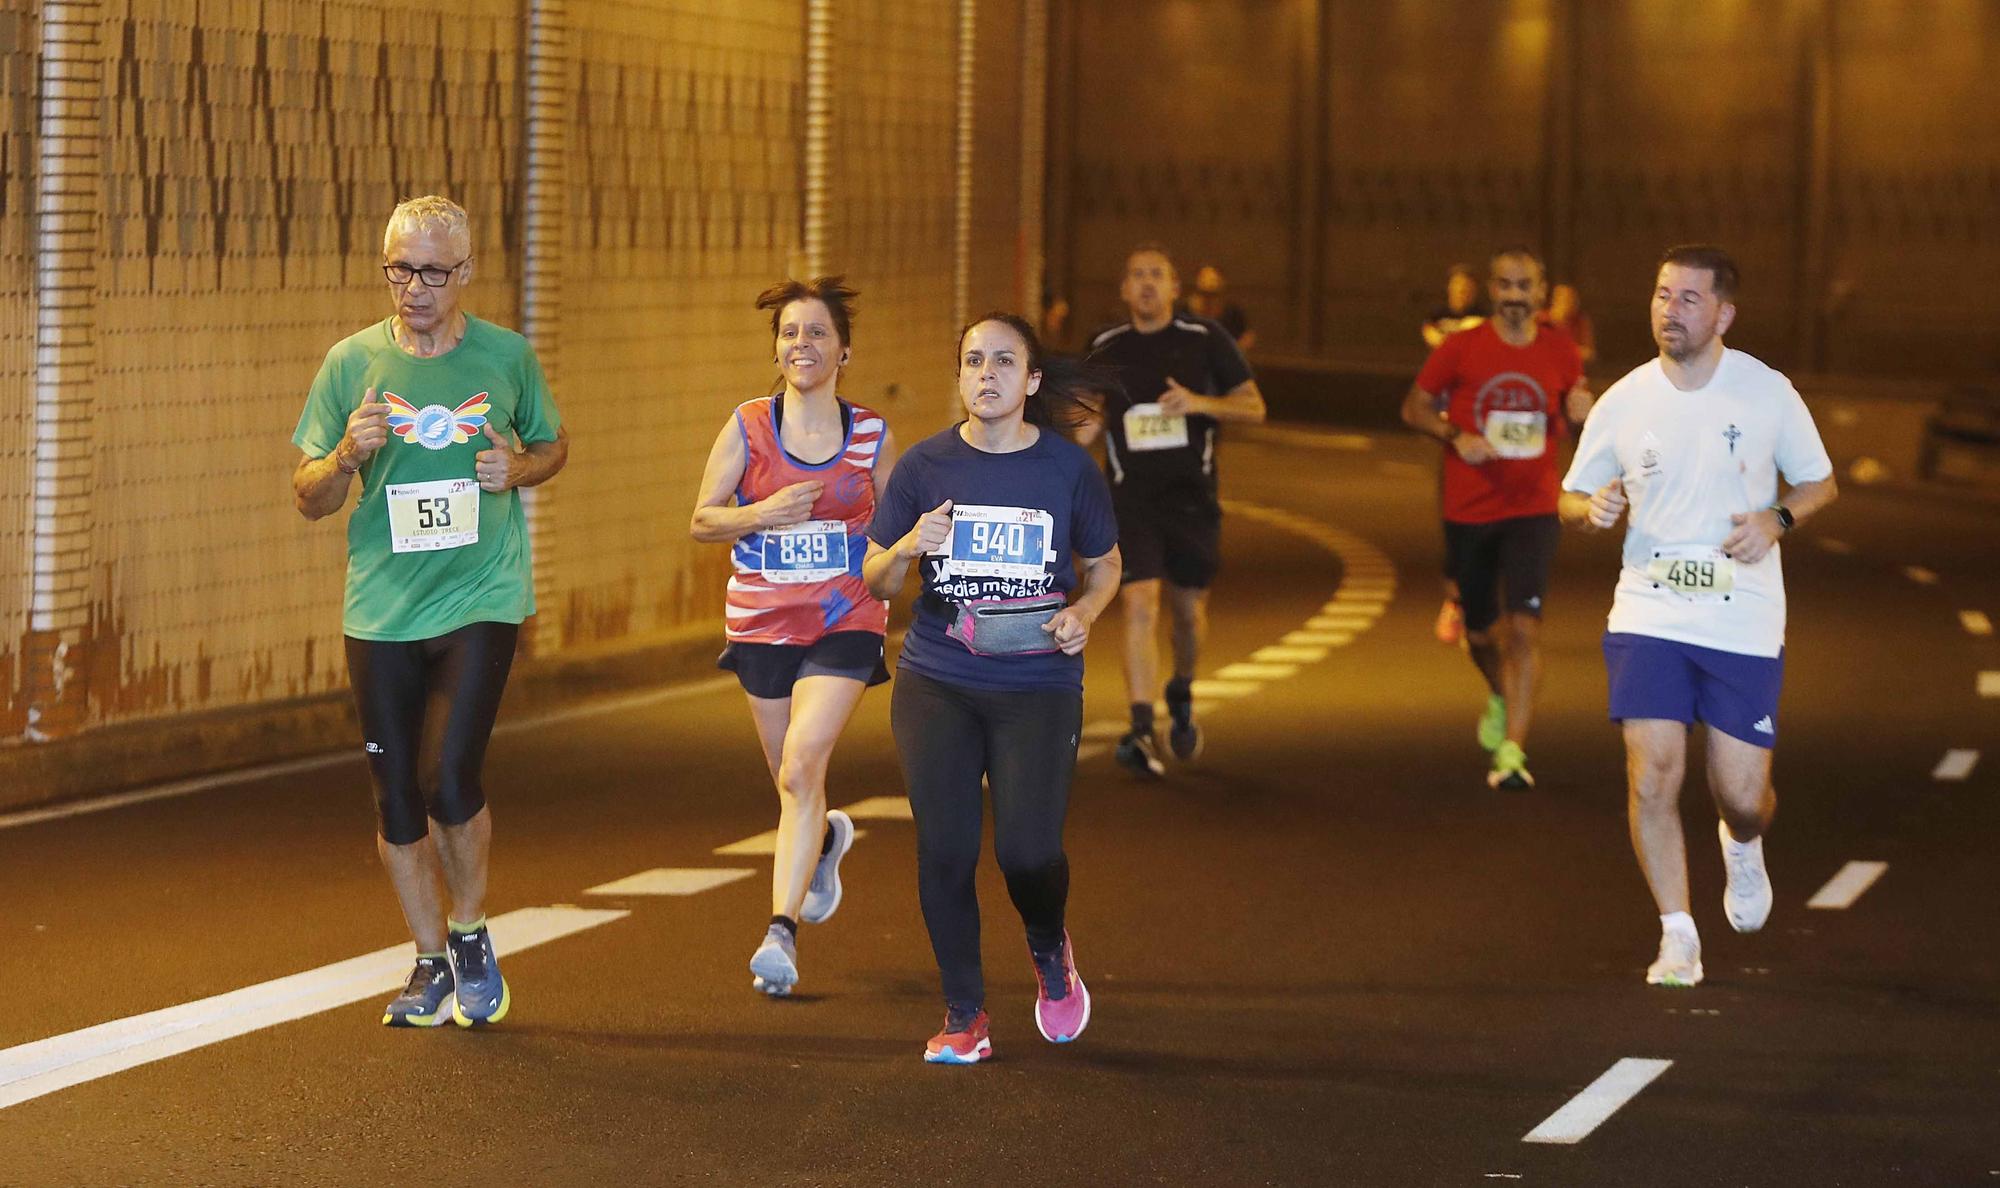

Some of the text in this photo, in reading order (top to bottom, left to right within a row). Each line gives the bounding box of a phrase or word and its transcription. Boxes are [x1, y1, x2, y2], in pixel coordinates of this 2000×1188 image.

[417, 497, 451, 529] 53
[780, 534, 828, 564] 839
[971, 522, 1025, 556] 940
[1667, 560, 1714, 587] 489
